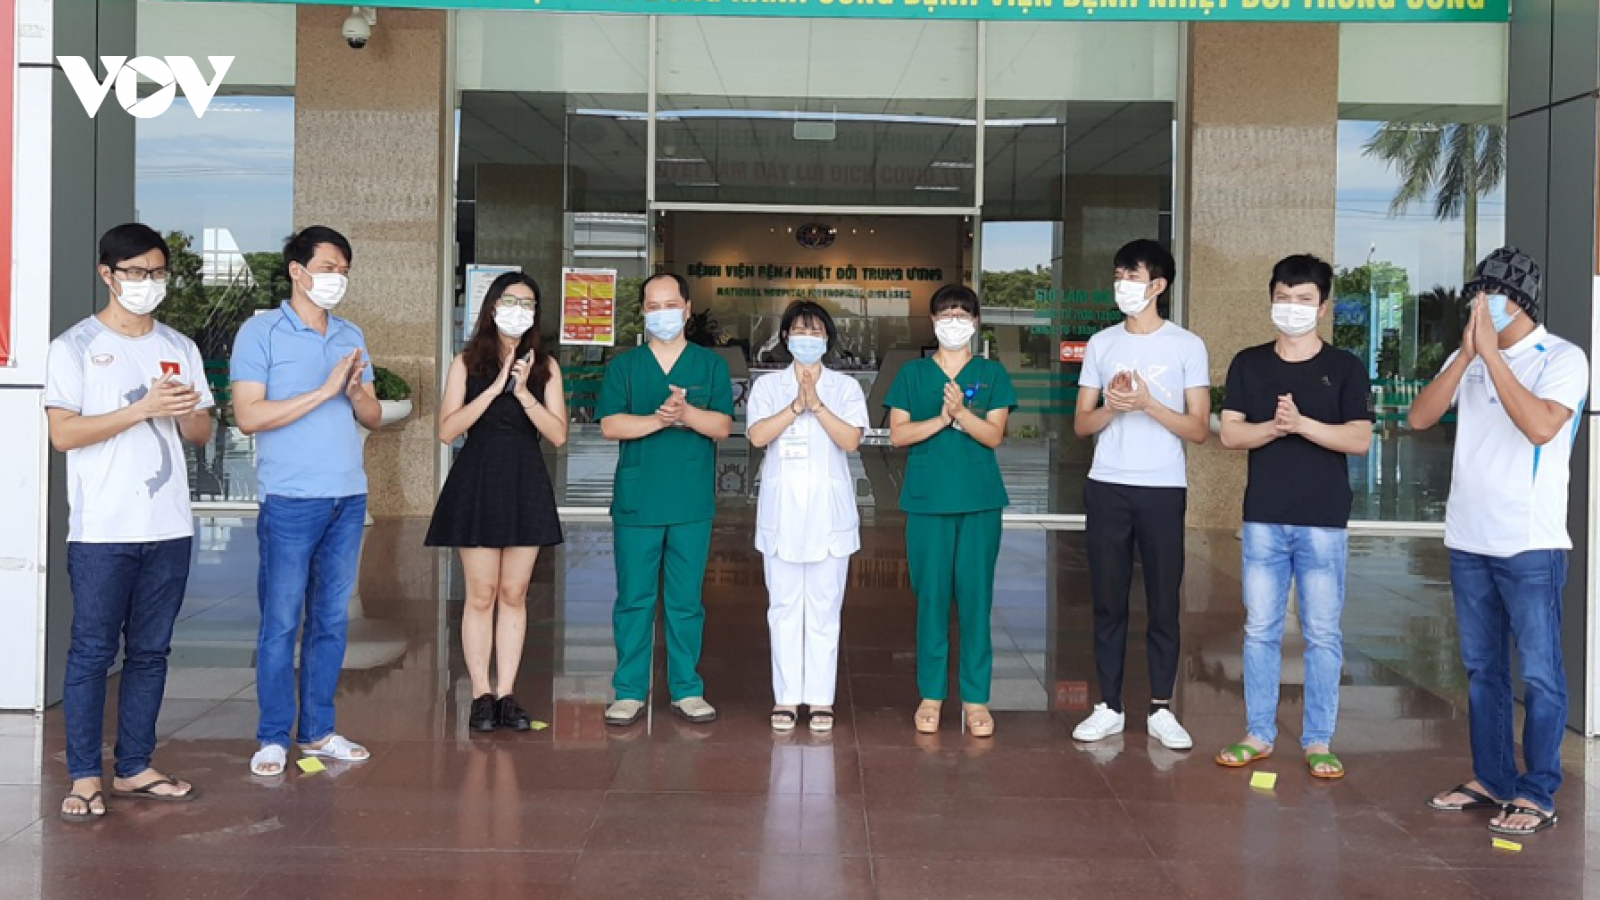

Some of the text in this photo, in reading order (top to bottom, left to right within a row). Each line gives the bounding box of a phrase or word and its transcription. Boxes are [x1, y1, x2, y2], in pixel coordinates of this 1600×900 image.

[726, 262, 754, 280] VIỆN
[796, 264, 832, 282] NHIỆT
[862, 267, 903, 281] TRUNG
